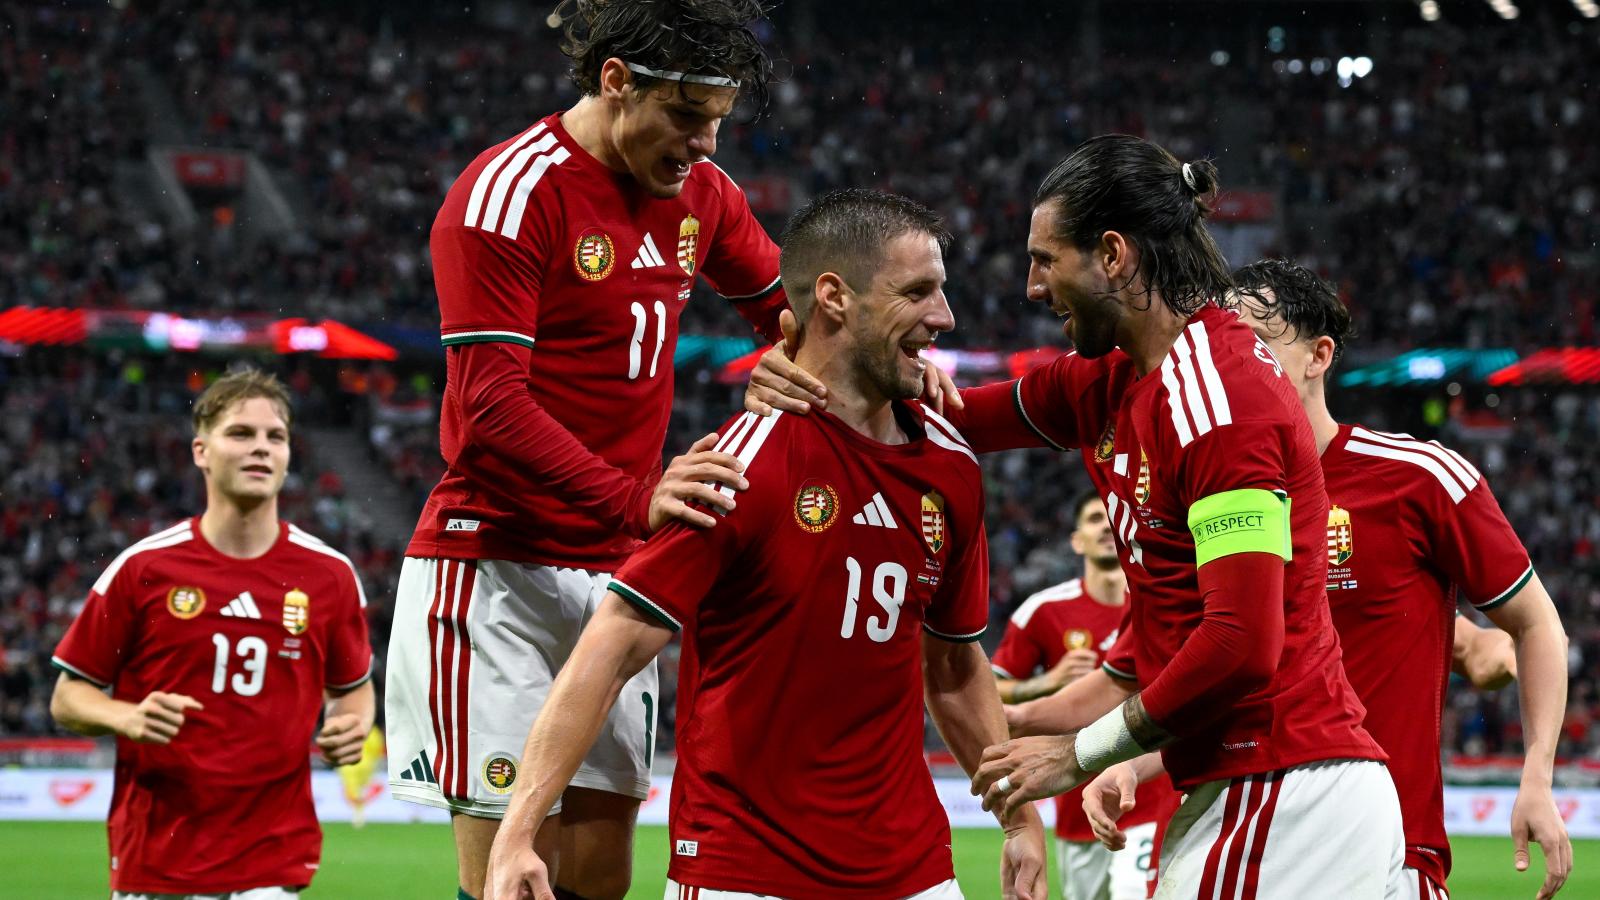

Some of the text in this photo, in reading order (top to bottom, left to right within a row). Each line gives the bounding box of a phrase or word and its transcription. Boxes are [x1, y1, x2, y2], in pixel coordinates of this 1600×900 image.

[628, 300, 667, 380] 11
[810, 525, 824, 533] 125
[1205, 515, 1264, 536] RESPECT
[840, 556, 908, 643] 19
[211, 632, 268, 697] 13
